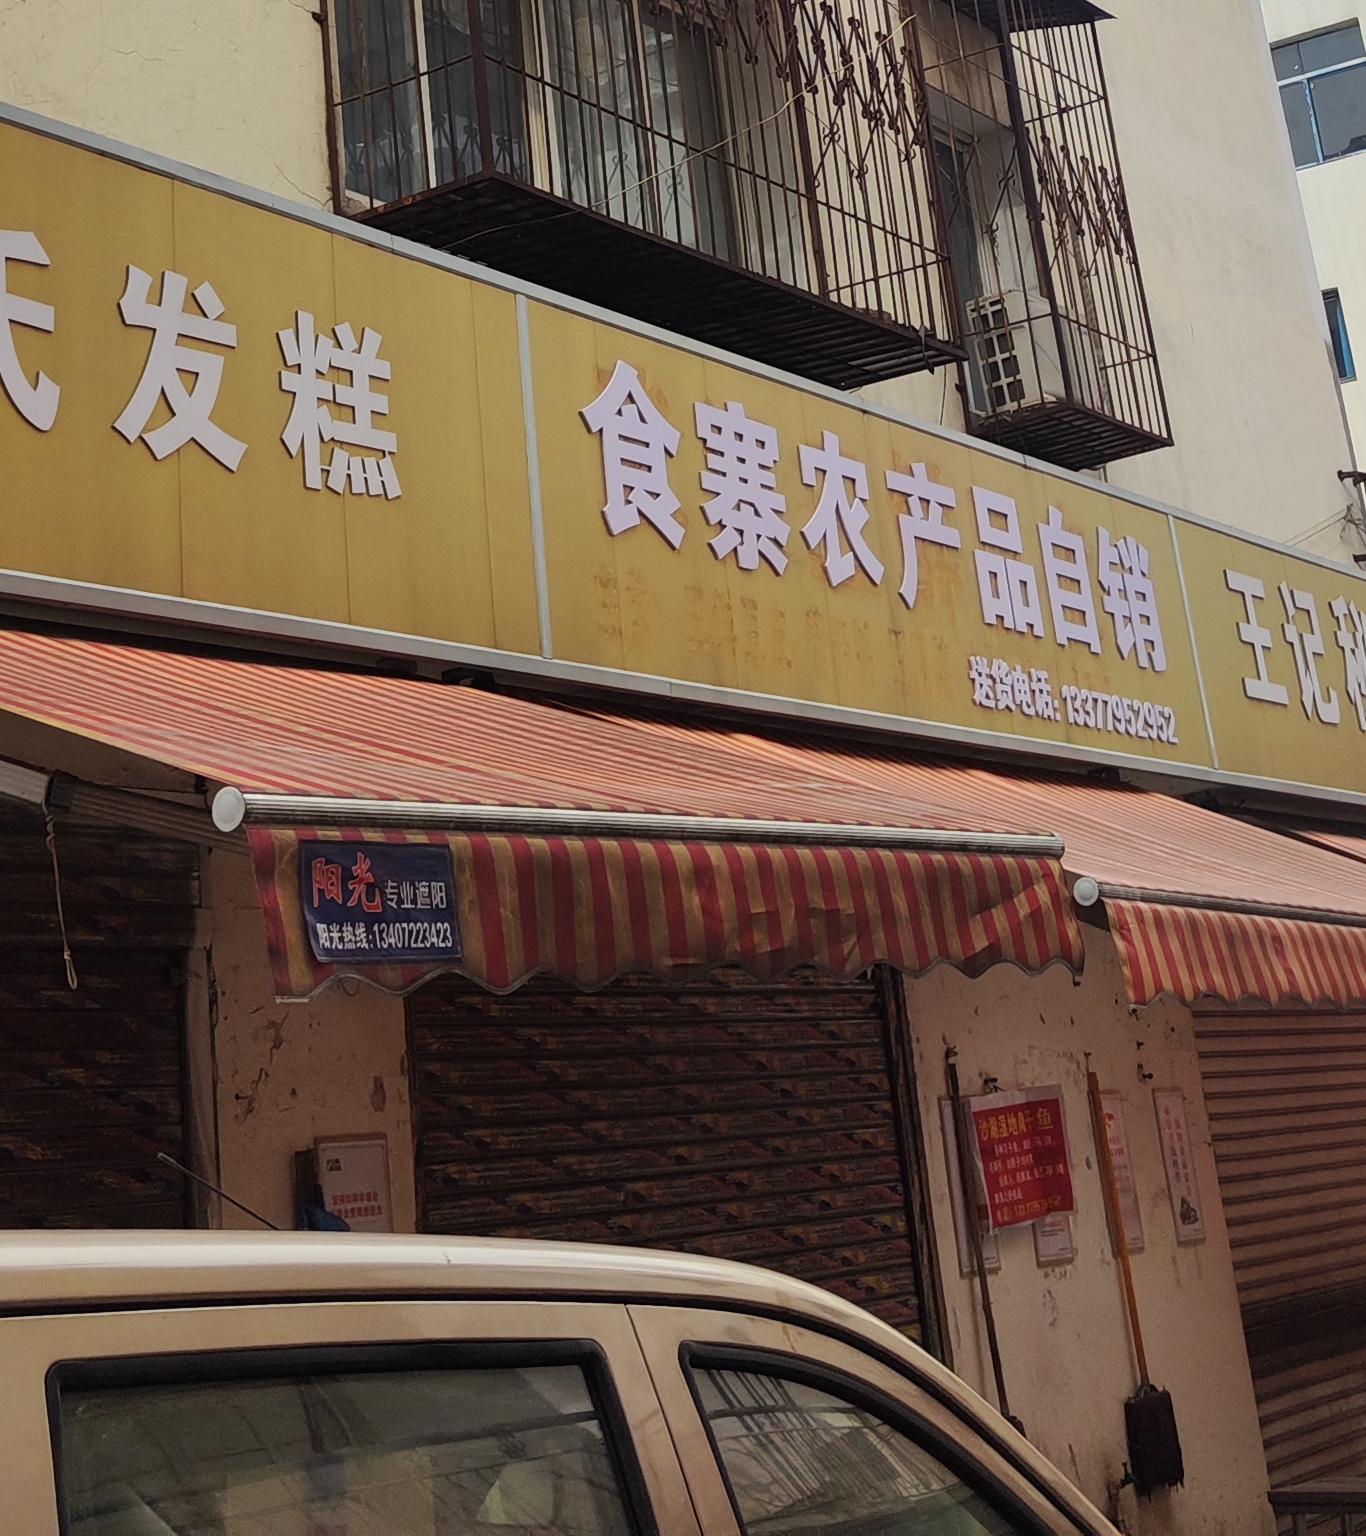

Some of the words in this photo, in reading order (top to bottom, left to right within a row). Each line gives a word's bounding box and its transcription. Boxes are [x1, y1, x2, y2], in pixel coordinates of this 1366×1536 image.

[579, 360, 1167, 672] 食寨农产品自销
[311, 851, 383, 913] 阳光
[385, 879, 447, 910] 专业遮阳
